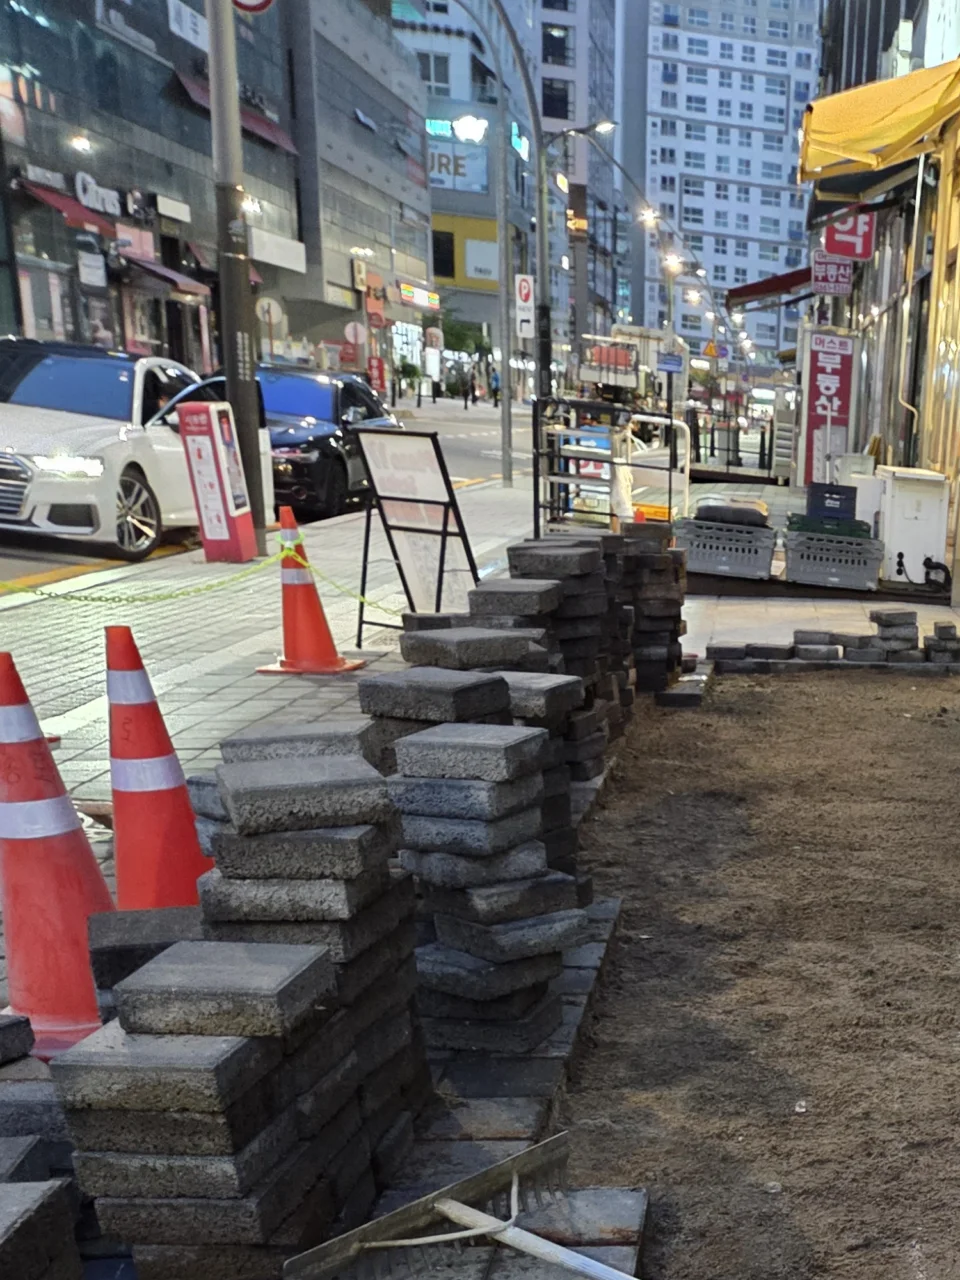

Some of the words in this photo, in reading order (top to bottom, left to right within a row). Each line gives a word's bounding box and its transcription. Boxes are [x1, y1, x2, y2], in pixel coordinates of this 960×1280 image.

[814, 264, 850, 283] 부동산
[814, 336, 849, 351] 머스트
[815, 352, 842, 416] 부동산
